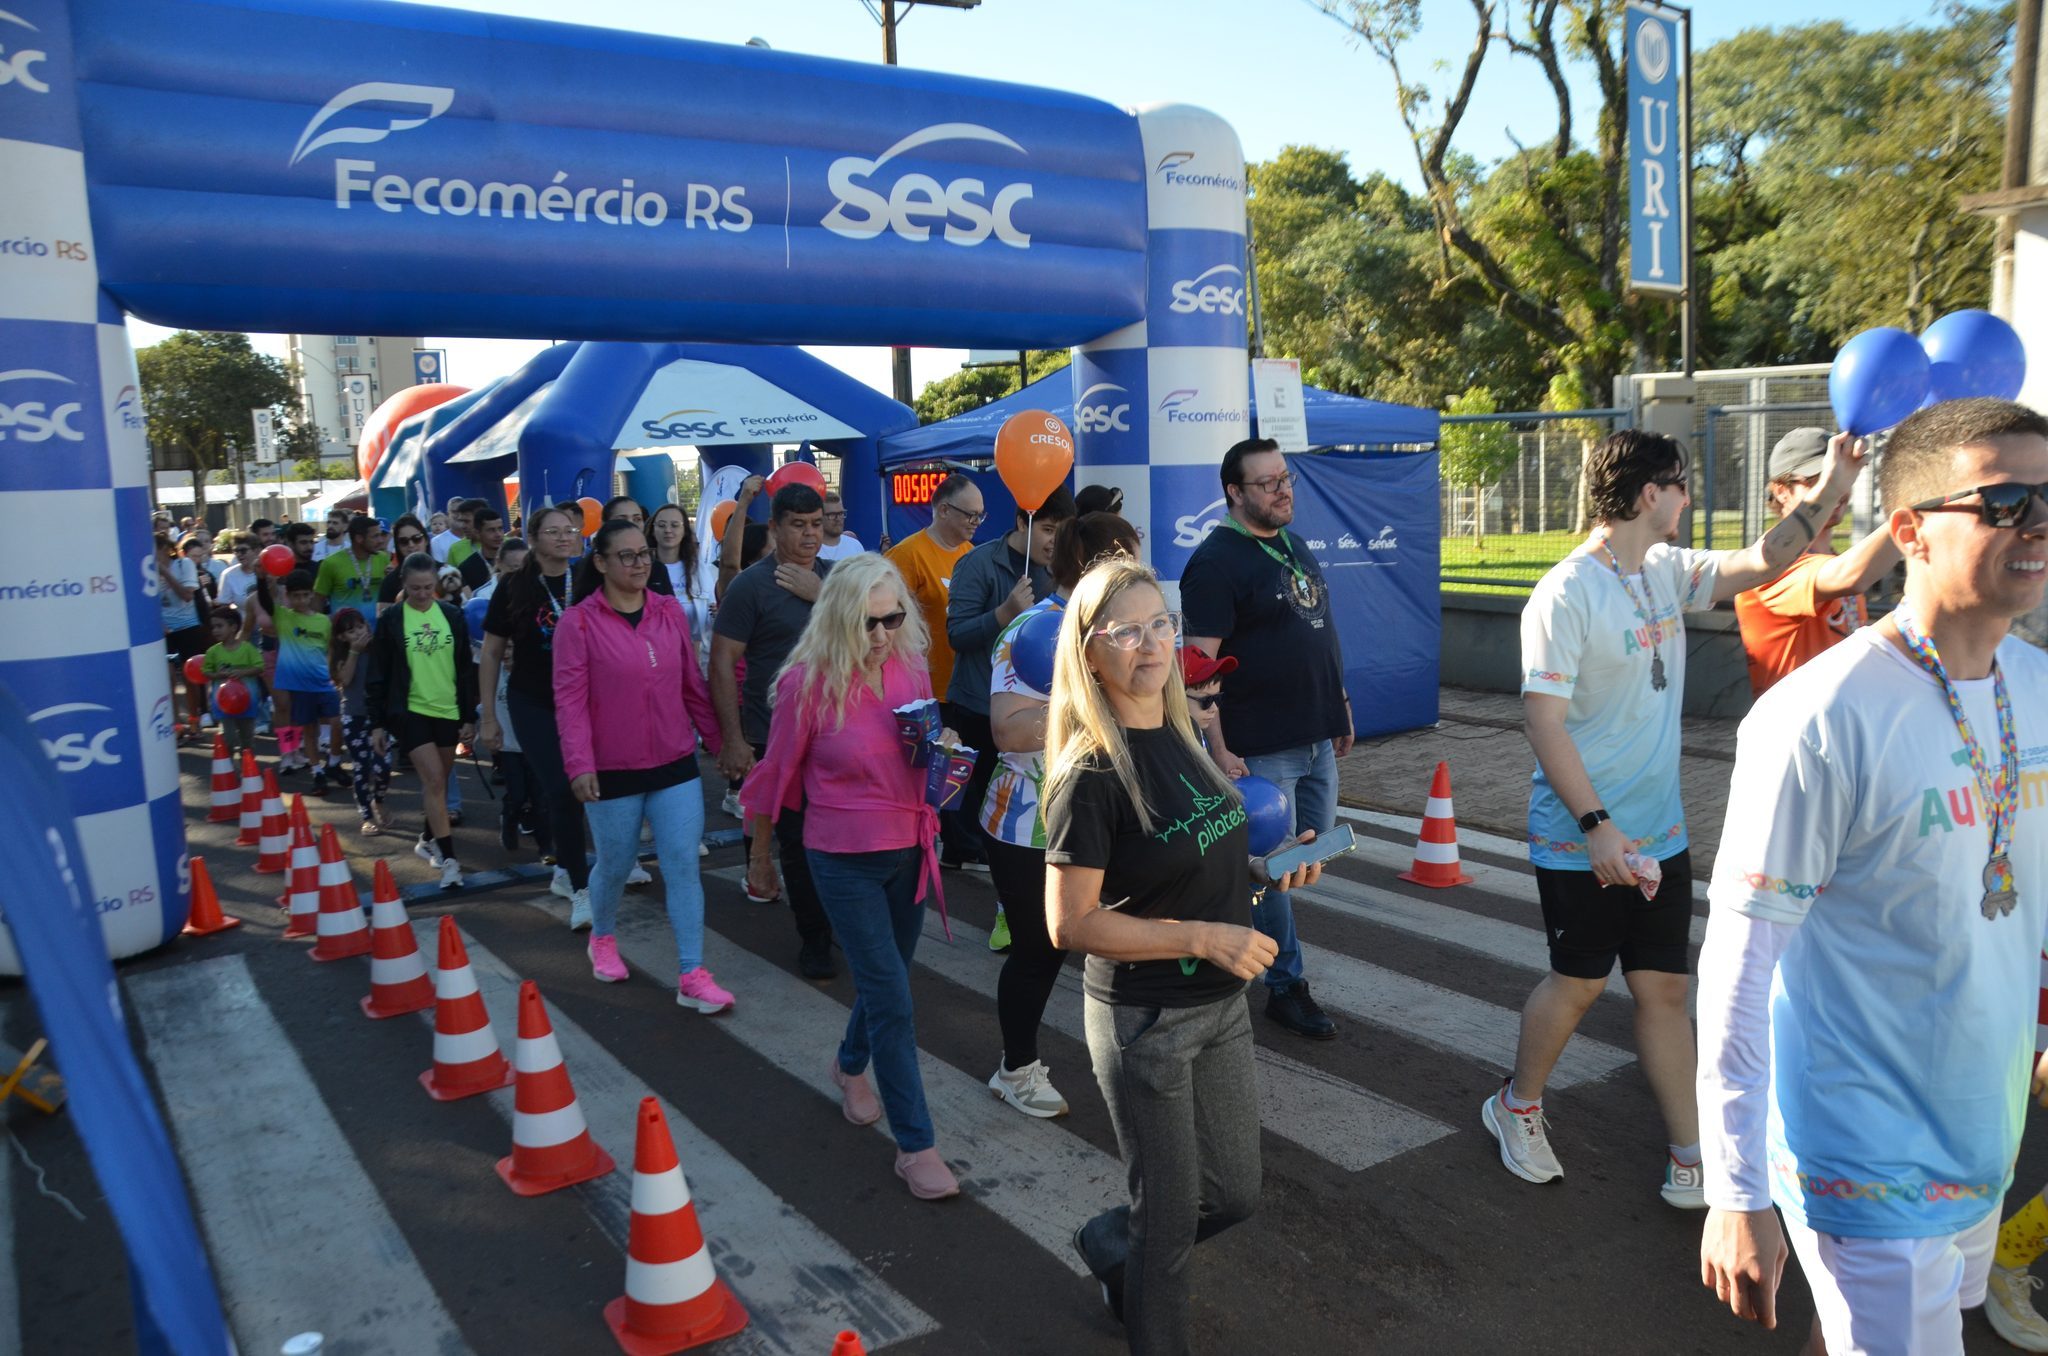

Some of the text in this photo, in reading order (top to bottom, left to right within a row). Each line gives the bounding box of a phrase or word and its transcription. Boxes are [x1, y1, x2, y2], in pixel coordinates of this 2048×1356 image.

[1166, 171, 1238, 190] Fecomércio
[1640, 96, 1669, 278] URI
[335, 158, 752, 232] Fecomércio RS
[820, 156, 1033, 248] Sesc
[56, 240, 88, 261] RS
[1169, 279, 1243, 315] Sesc
[740, 413, 818, 426] Fecomércio
[1168, 409, 1241, 423] Fecomércio
[642, 420, 734, 439] Sesc
[90, 576, 118, 594] RS
[1198, 804, 1246, 856] pilates
